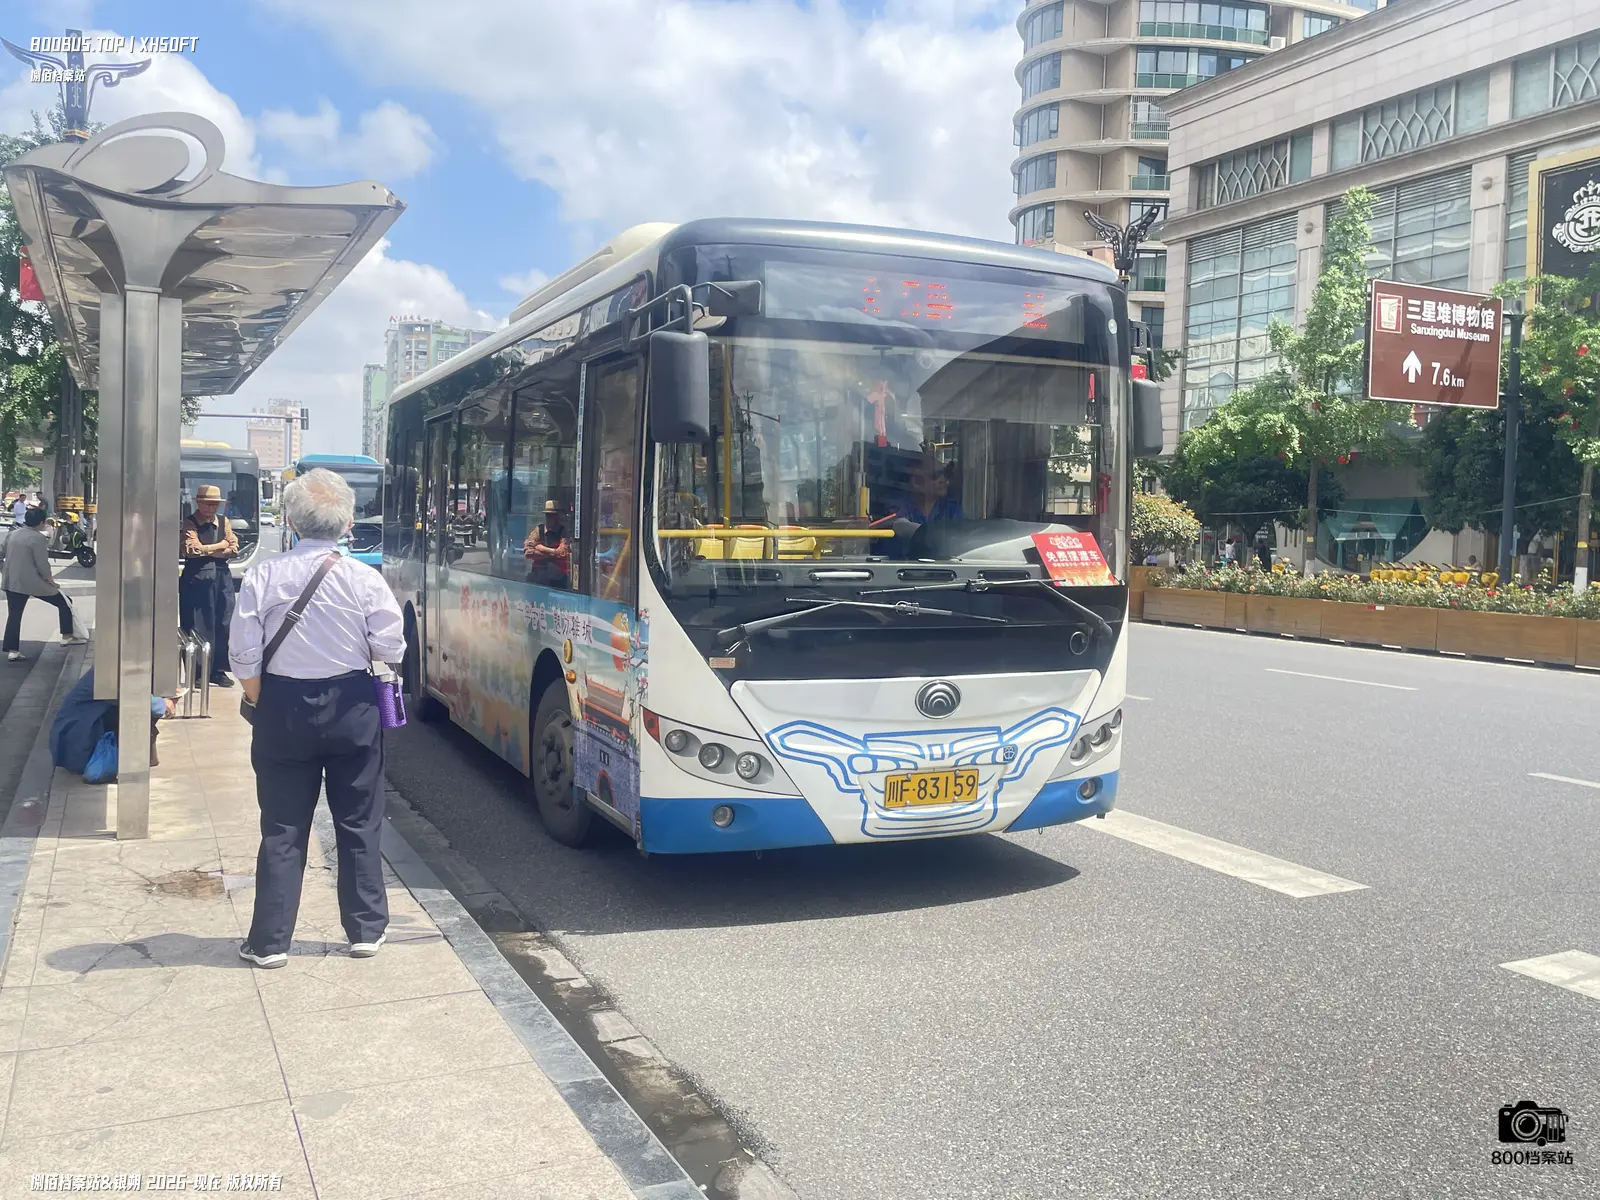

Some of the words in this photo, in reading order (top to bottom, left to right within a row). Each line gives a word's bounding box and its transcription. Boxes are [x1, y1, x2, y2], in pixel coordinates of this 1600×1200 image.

[1406, 299, 1495, 330] 三星堆博物馆
[1410, 322, 1456, 340] Sanxingdui
[1456, 328, 1490, 342] Museum
[1045, 550, 1101, 562] 免费摆渡车
